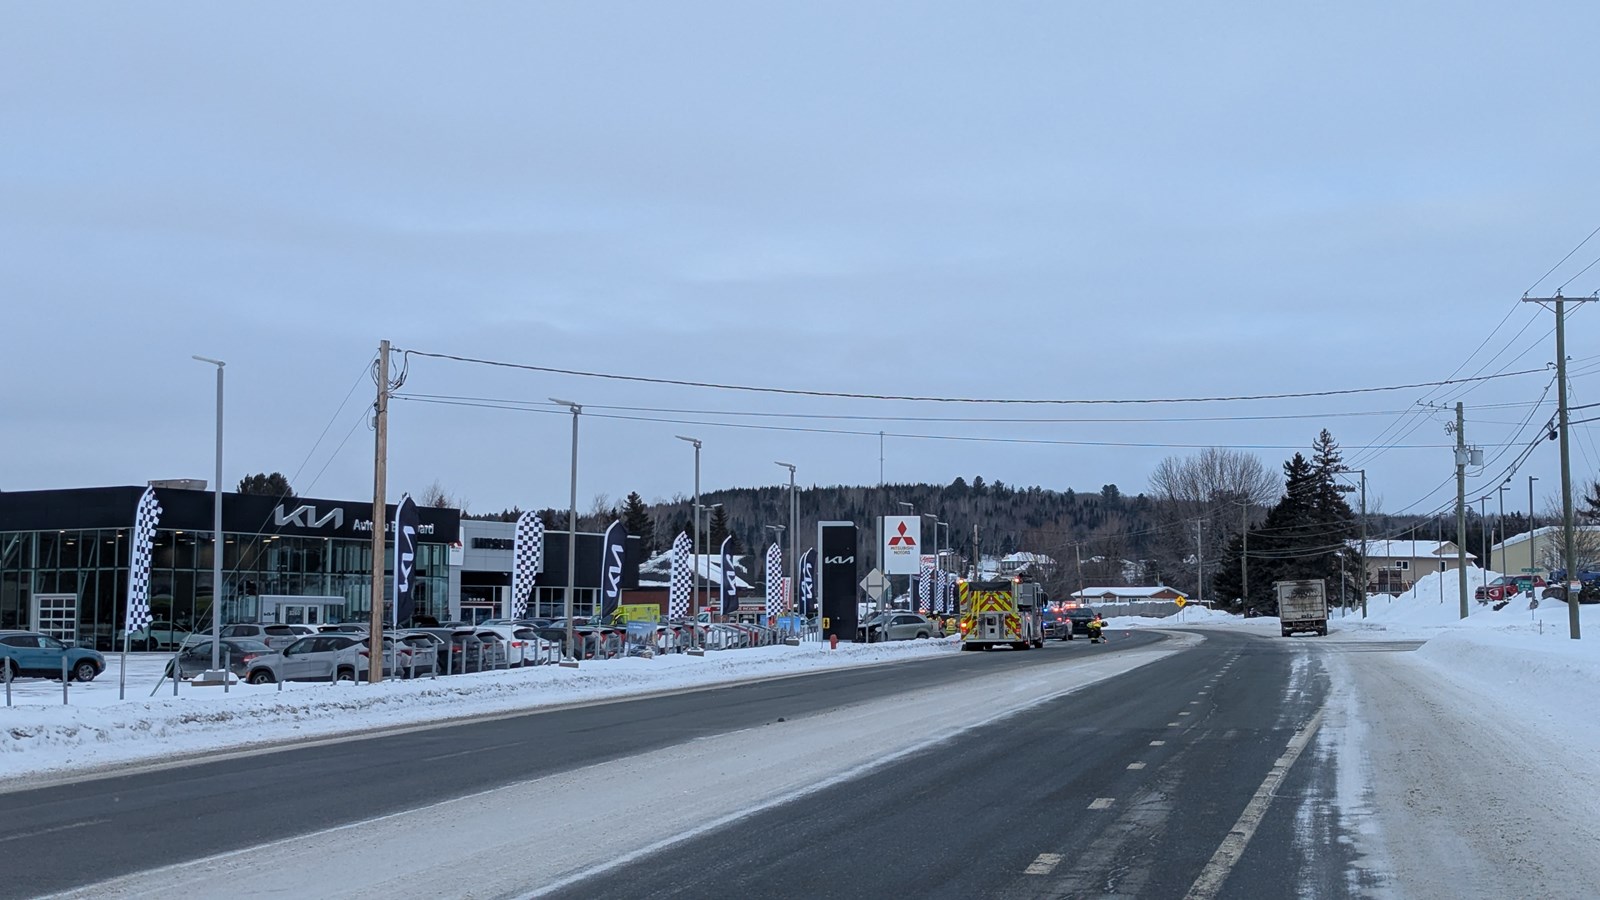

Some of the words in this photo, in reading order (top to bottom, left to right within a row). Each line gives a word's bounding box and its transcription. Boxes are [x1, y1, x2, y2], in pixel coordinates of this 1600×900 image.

[275, 504, 344, 529] KIA
[398, 526, 416, 593] KIA
[606, 544, 624, 598] KIA
[825, 556, 854, 564] KIA
